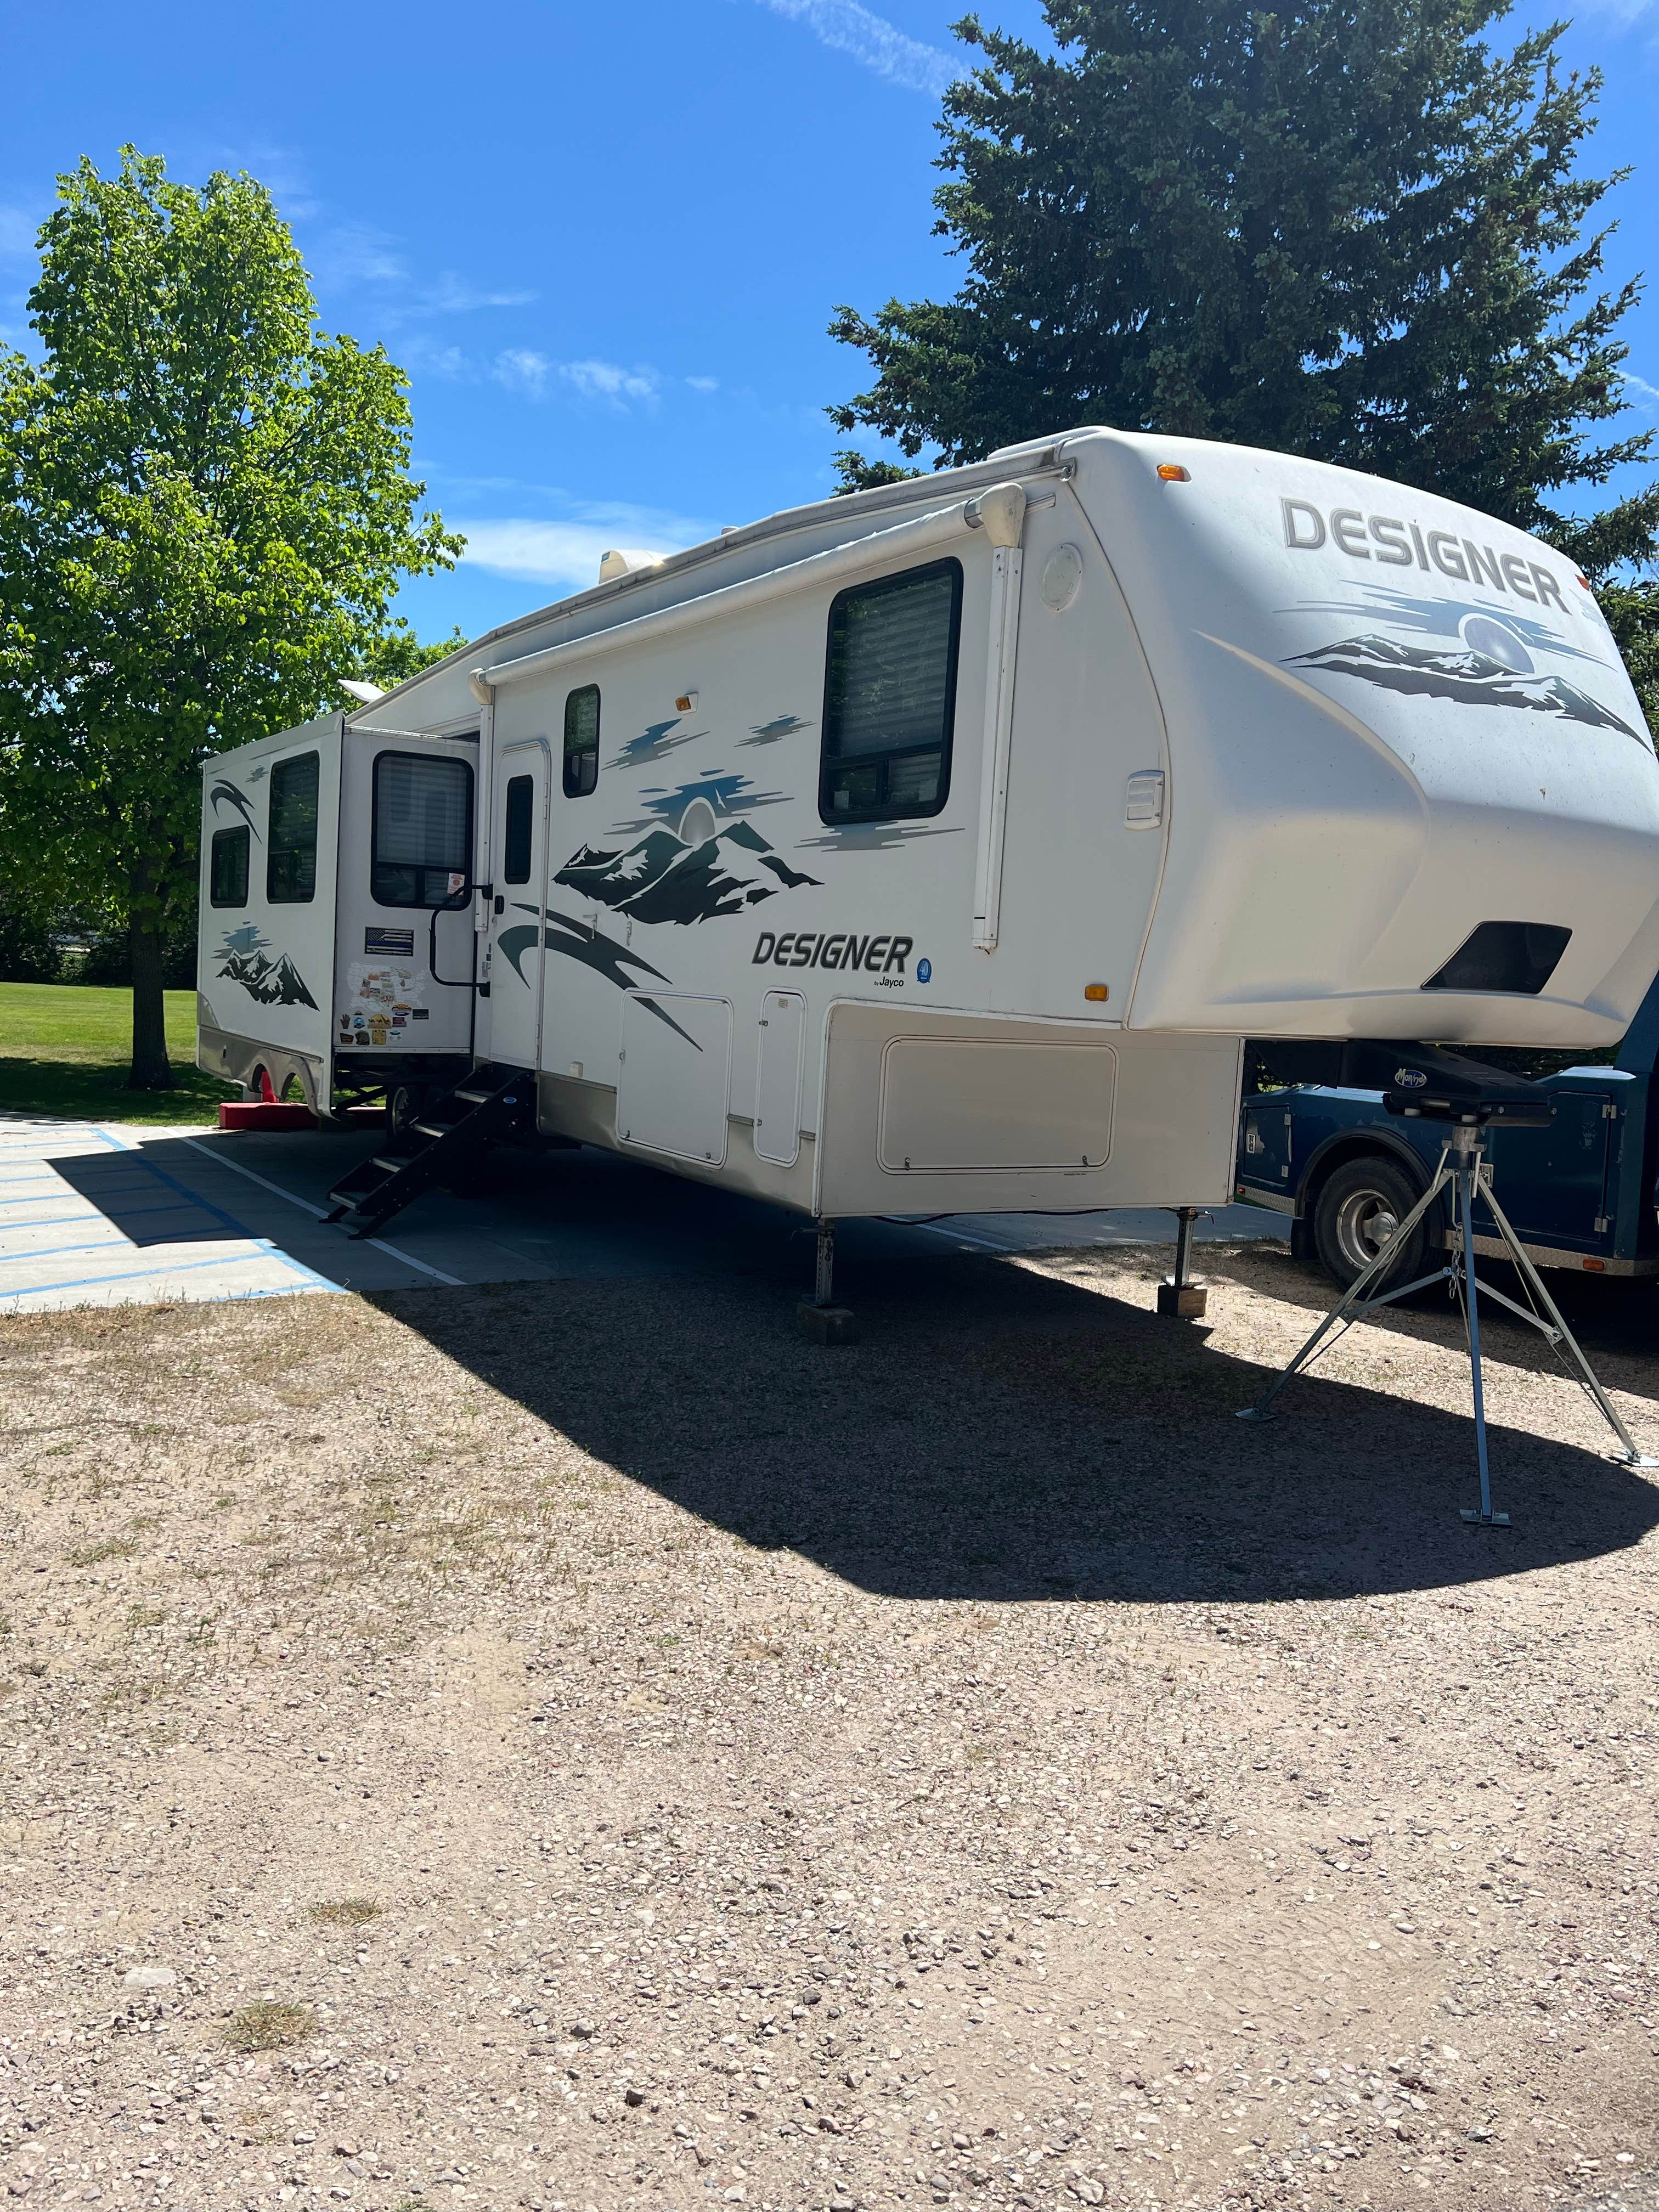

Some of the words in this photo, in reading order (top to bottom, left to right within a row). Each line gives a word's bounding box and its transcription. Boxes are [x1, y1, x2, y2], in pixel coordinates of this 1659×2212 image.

[1280, 496, 1572, 615] DESIGNER
[751, 932, 913, 974] DESIGNER
[879, 977, 904, 988] Jayco
[919, 962, 928, 976] 40
